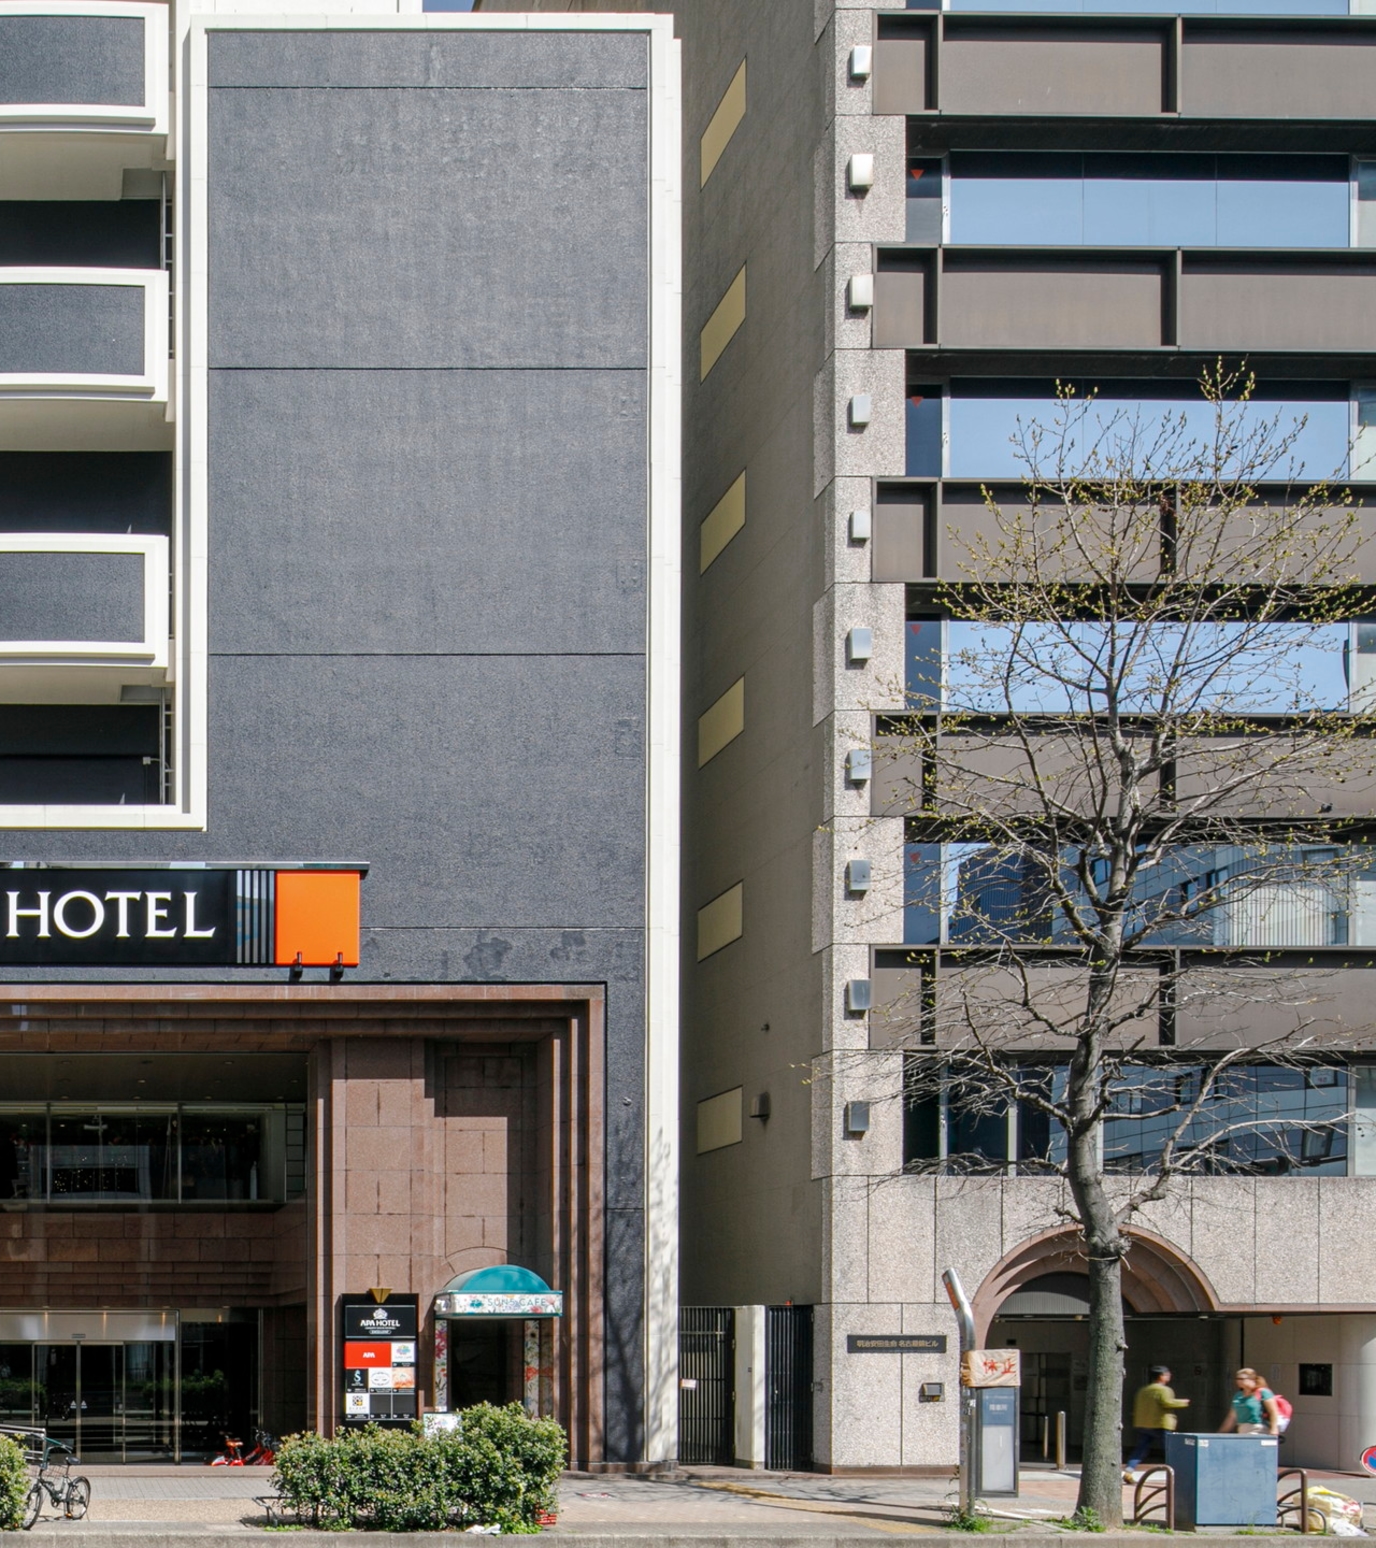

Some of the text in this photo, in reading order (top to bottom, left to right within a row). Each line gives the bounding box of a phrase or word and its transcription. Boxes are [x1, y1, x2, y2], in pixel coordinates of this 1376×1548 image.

[5, 890, 216, 938] HOTEL
[519, 1297, 546, 1307] CAFE
[376, 1319, 400, 1327] HOTEL
[983, 1358, 1016, 1375] 休止
